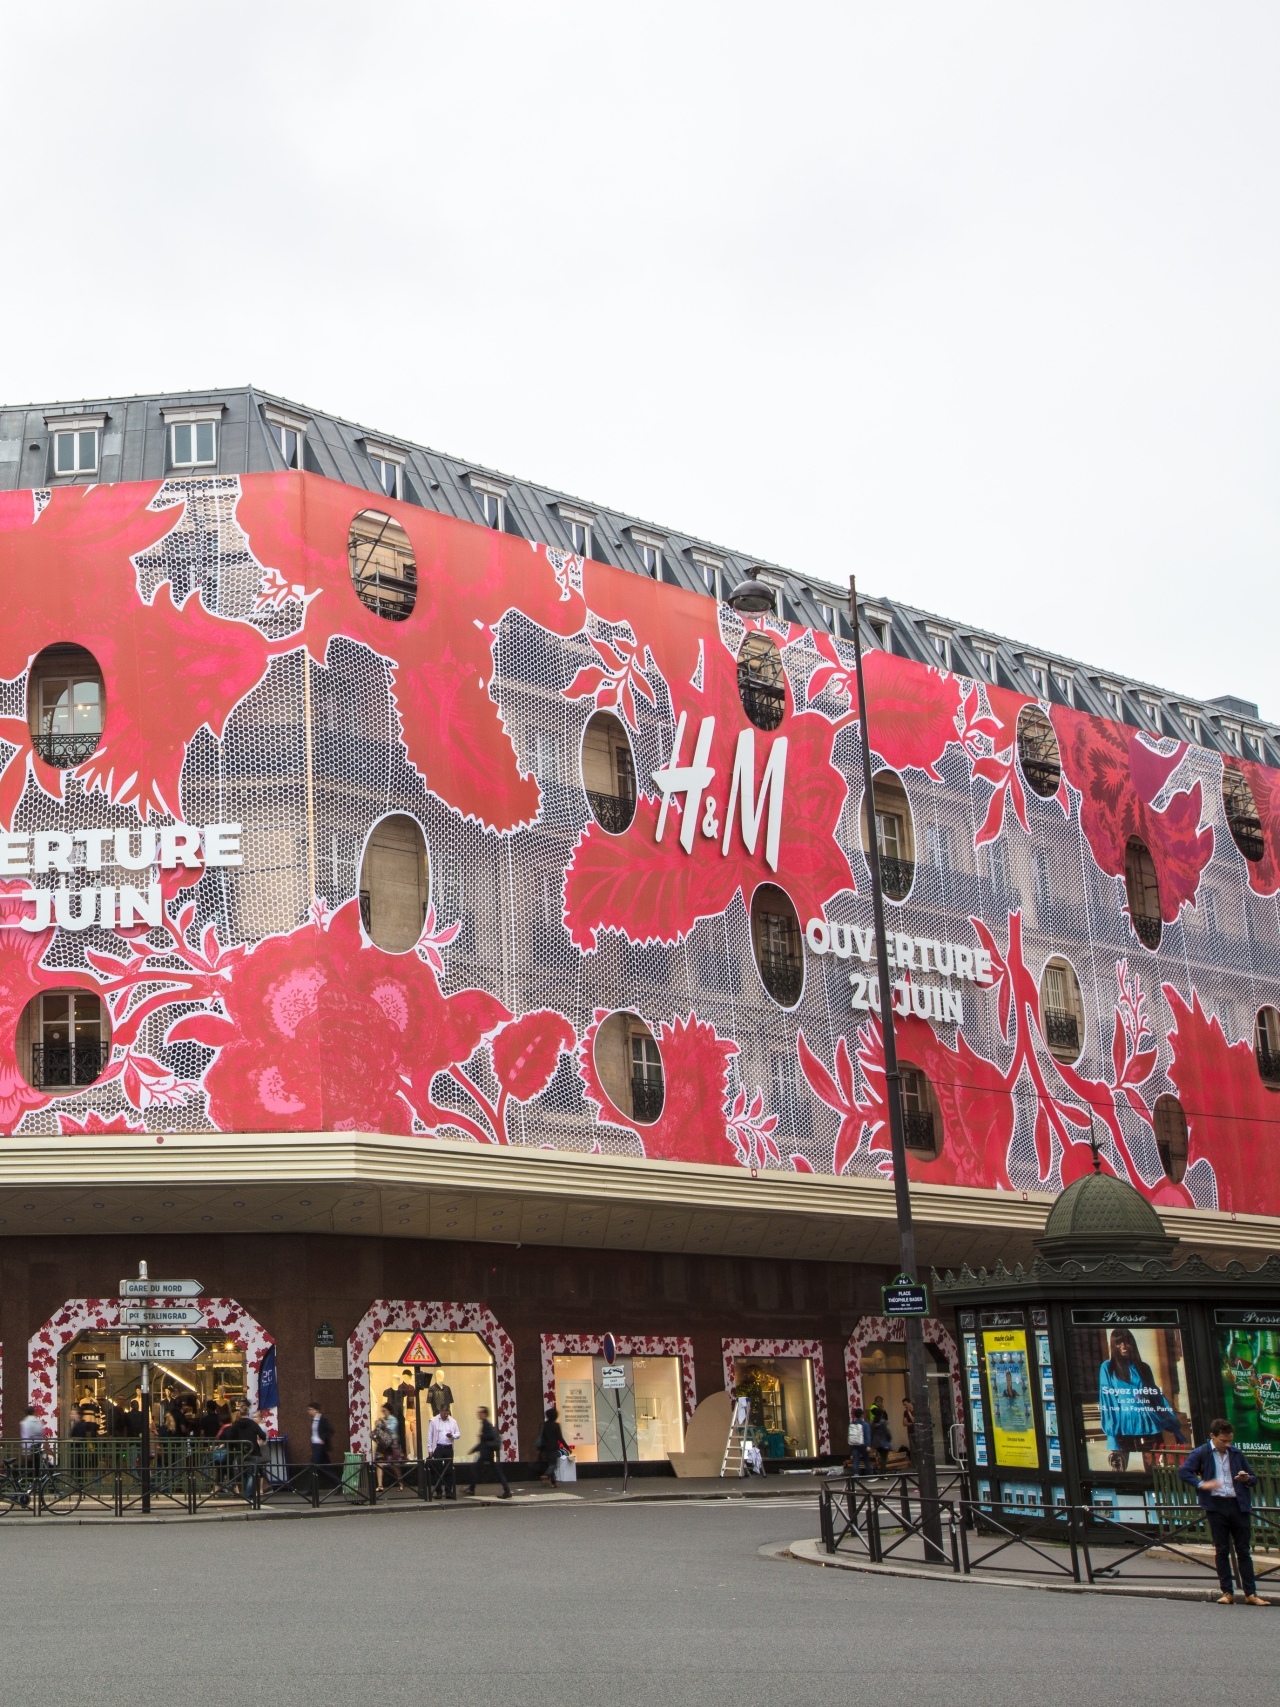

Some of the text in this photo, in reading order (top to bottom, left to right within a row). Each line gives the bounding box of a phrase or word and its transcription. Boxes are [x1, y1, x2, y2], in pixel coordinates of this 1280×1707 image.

[652, 710, 788, 873] H&M
[19, 884, 163, 932] JUIN
[805, 918, 993, 983] OUVERTURE
[895, 981, 964, 1025] JUIN
[1102, 1311, 1148, 1322] Presse
[1102, 1387, 1131, 1397] Soyez
[1132, 1387, 1158, 1397] prêts
[1260, 1390, 1280, 1399] ESPAG
